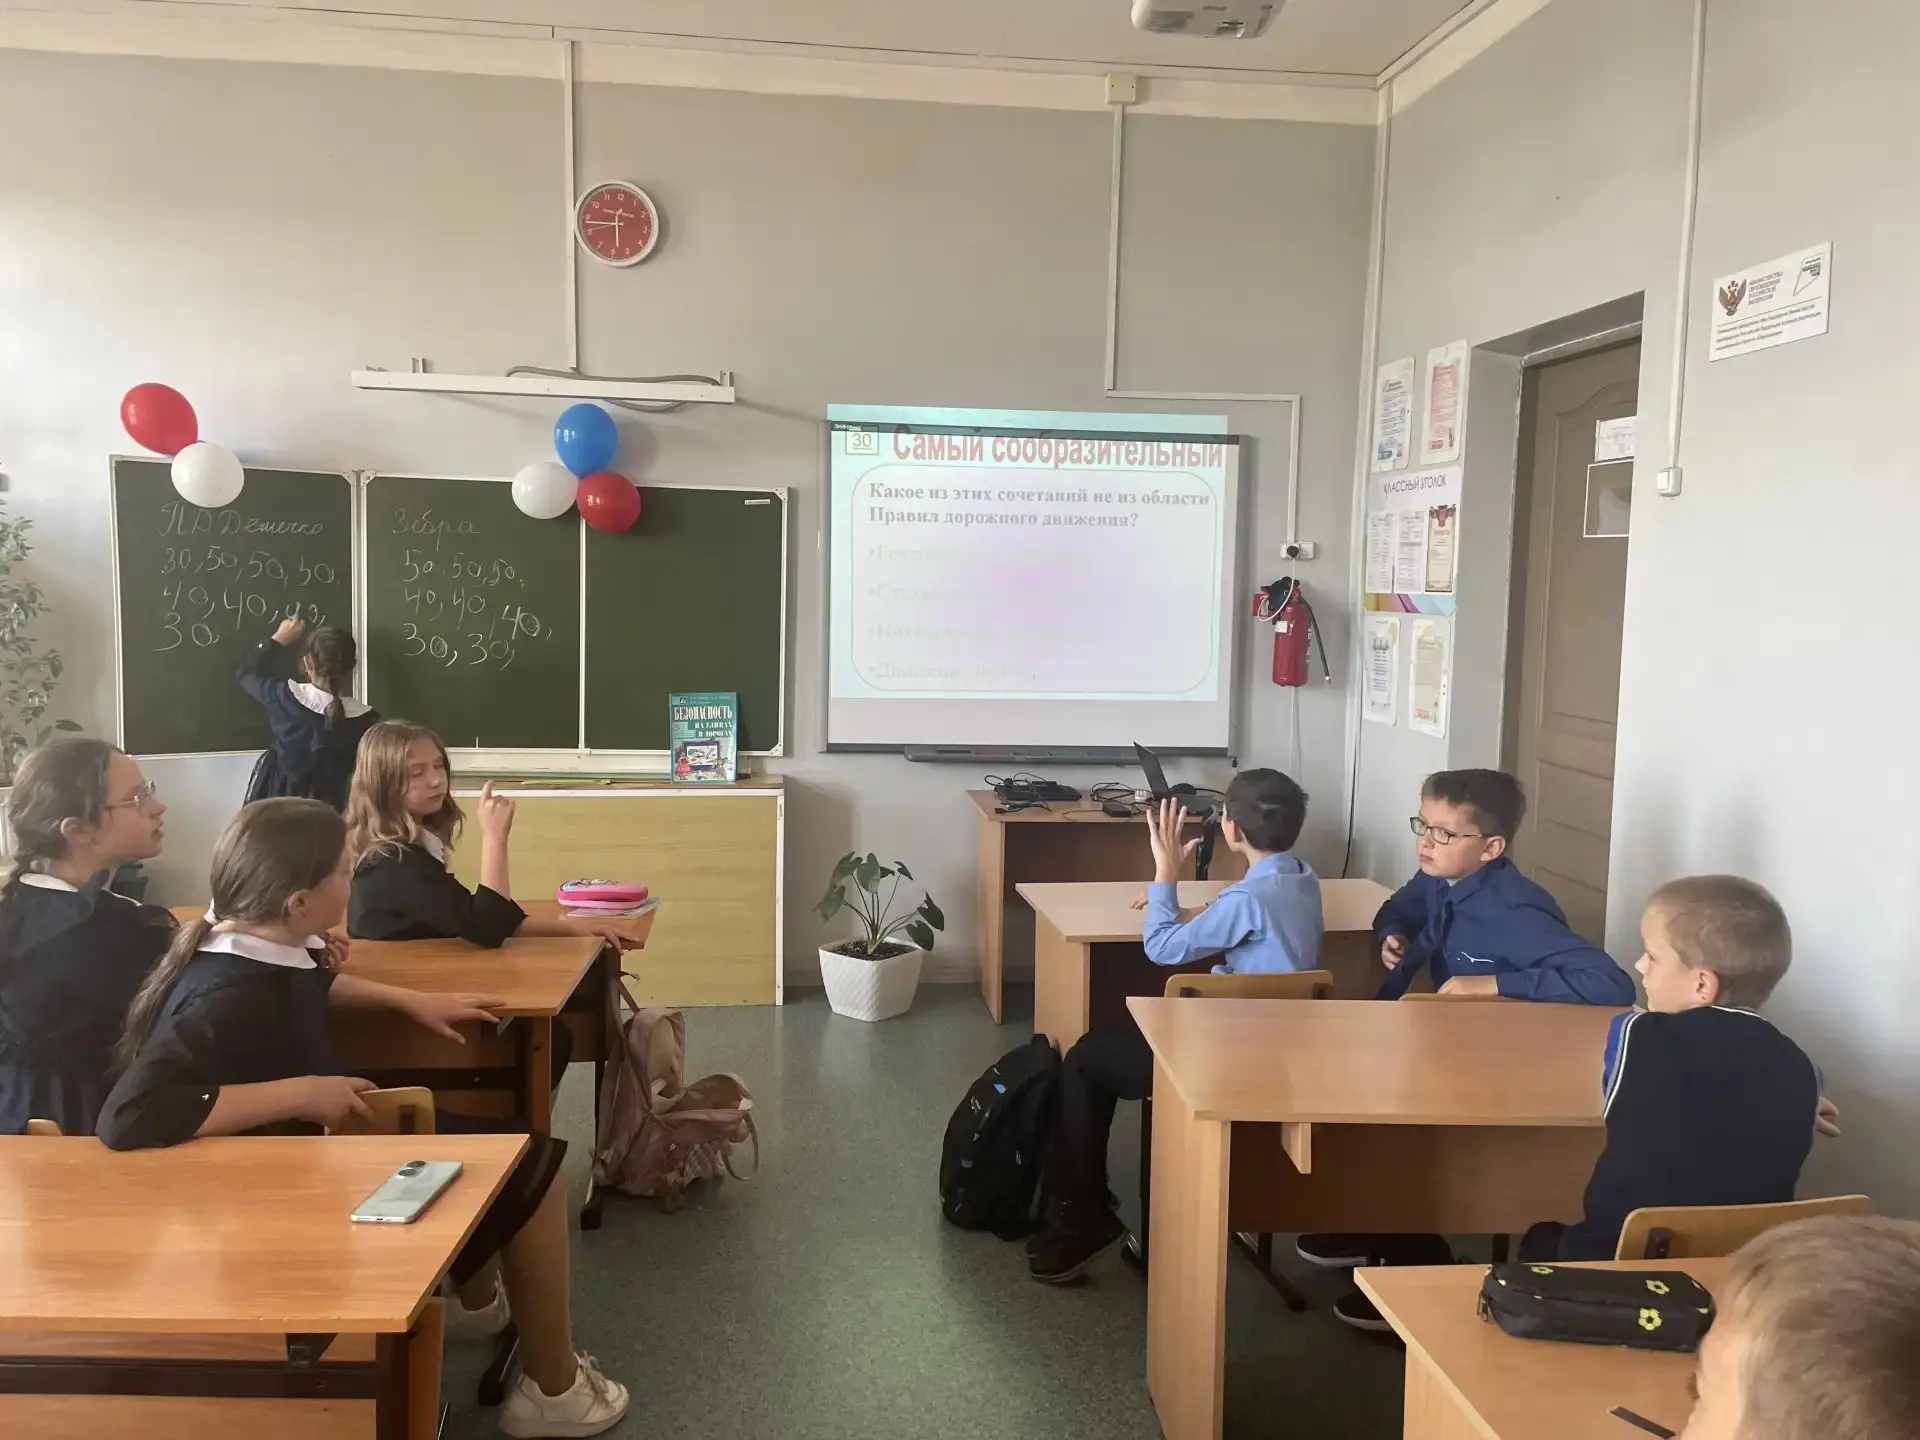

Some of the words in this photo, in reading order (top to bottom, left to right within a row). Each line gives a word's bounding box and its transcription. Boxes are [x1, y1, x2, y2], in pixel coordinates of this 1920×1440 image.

[852, 433, 872, 447] 30
[893, 424, 984, 461] Самый
[992, 429, 1222, 469] сообразительный
[870, 482, 924, 499] Какое
[929, 488, 948, 499] из
[953, 488, 992, 501] этих
[997, 489, 1088, 503] сочетаний
[1093, 492, 1113, 504] не
[1118, 492, 1136, 504] из
[1142, 490, 1209, 506] области
[1384, 476, 1419, 494] КЛАССНЫЙ
[1420, 474, 1447, 492] УГОЛОК
[870, 507, 938, 526] Правил
[943, 510, 1038, 527] дорожного
[1042, 512, 1138, 528] движения?
[393, 508, 482, 551] Зебра
[674, 705, 732, 721] БЕЗОПАСНОСТЬ
